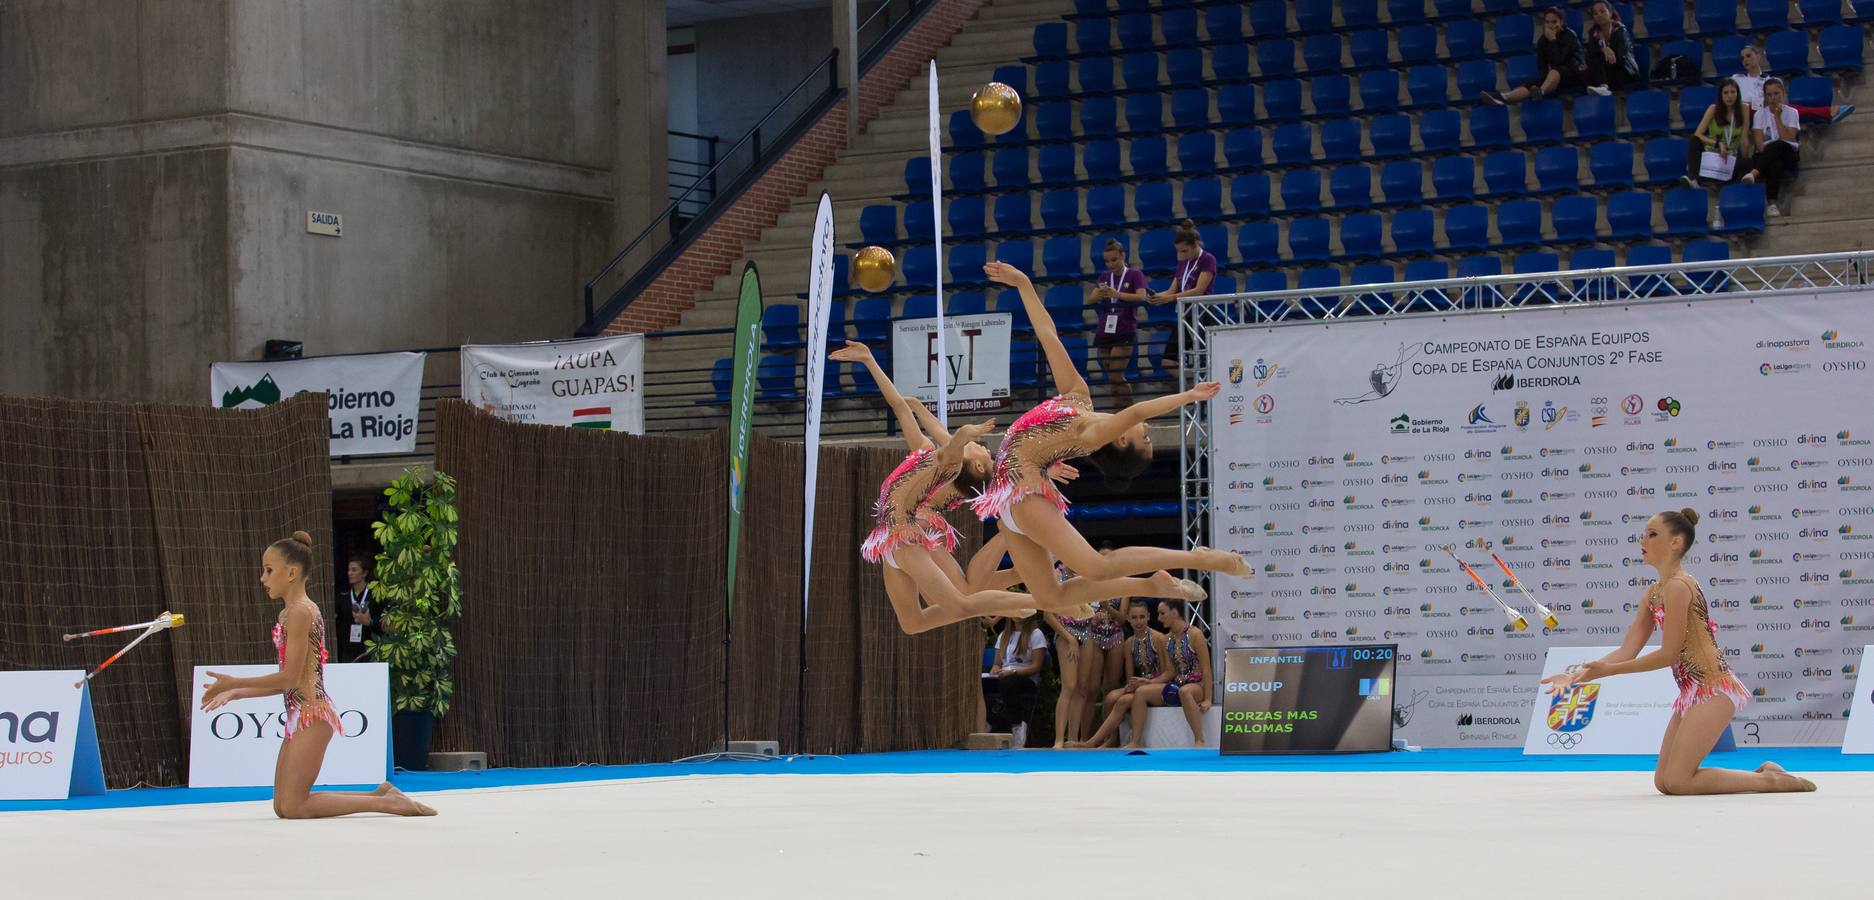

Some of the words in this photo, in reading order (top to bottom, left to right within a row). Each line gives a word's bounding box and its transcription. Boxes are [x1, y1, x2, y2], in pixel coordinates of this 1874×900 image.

[311, 212, 339, 226] SALIDA
[981, 318, 1006, 327] Laborales
[1423, 339, 1510, 355] CAMPEONATO
[1514, 338, 1532, 351] DE
[1536, 334, 1587, 349] ESPAÑA
[1591, 331, 1651, 346] EQUIPOS
[1825, 341, 1865, 350] IBERDROLA
[554, 350, 617, 371] ¡AUPA
[1412, 362, 1448, 376] COPA
[1451, 362, 1468, 374] DE
[1472, 357, 1523, 373] ESPAÑA
[1526, 354, 1606, 370] CONJUNTOS
[1628, 350, 1664, 364] FASE
[1822, 360, 1866, 373] OYSHO
[479, 370, 498, 380] Club
[499, 369, 507, 378] de
[508, 368, 540, 378] Gimnasia
[551, 374, 636, 398] GUAPAS!
[1516, 376, 1581, 389] IBERDROLA
[738, 324, 758, 458] IBERDROLA
[328, 388, 396, 411] bierno
[330, 417, 353, 441] La
[360, 413, 415, 442] Rioja
[1411, 419, 1443, 427] Gobierno
[1432, 426, 1450, 434] Rioja
[1753, 439, 1787, 447] OYSHO
[1797, 435, 1826, 443] divina
[1584, 446, 1617, 454] OYSHO
[1626, 442, 1654, 451] divina
[1464, 450, 1491, 458] divina
[1708, 461, 1736, 470] divina
[1838, 458, 1872, 467] OYSHO
[1541, 468, 1568, 476] divina
[1666, 465, 1699, 473] OYSHO
[1382, 474, 1408, 483] divina
[1501, 472, 1533, 480] OYSHO
[1229, 481, 1253, 489] divina
[1754, 484, 1788, 492] OYSHO
[1798, 480, 1827, 489] divina
[1627, 487, 1654, 495] divina
[1424, 497, 1455, 505] OYSHO
[1465, 493, 1491, 502] divina
[1309, 499, 1334, 507] divina
[1709, 509, 1737, 518] divina
[1839, 507, 1873, 515] OYSHO
[1542, 515, 1569, 523] divina
[1344, 524, 1374, 532] OYSHO
[1383, 520, 1408, 529] divina
[1229, 526, 1254, 534] divina
[1799, 528, 1828, 537] divina
[1755, 532, 1789, 541] OYSHO
[1310, 545, 1335, 553] divina
[1425, 543, 1456, 552] OYSO
[1543, 558, 1570, 566] divina
[1710, 553, 1738, 562] divina
[1383, 562, 1409, 571] divina
[1800, 573, 1829, 581] divina
[1586, 581, 1619, 589] OYSHO
[1310, 586, 1336, 594] divina
[1711, 599, 1739, 608] divina
[1231, 610, 1256, 618] divina
[1384, 607, 1410, 615] divina
[1801, 619, 1830, 628] divina
[1311, 630, 1336, 638] divina
[1427, 630, 1458, 638] OYSHO
[1467, 627, 1494, 635] divina
[1587, 626, 1619, 634] OYSHO
[1352, 648, 1393, 661] 00:20
[1504, 653, 1536, 661] OYSHO
[1249, 655, 1305, 665] INFANTIL
[1758, 671, 1792, 679] OYSHO
[1803, 667, 1831, 676] divina
[1226, 681, 1284, 693] GROUP
[1225, 711, 1283, 721] CORZAS
[1287, 710, 1319, 721] MAS
[1474, 717, 1521, 725] IBERDROLA
[1224, 723, 1295, 734] PALOMAS
